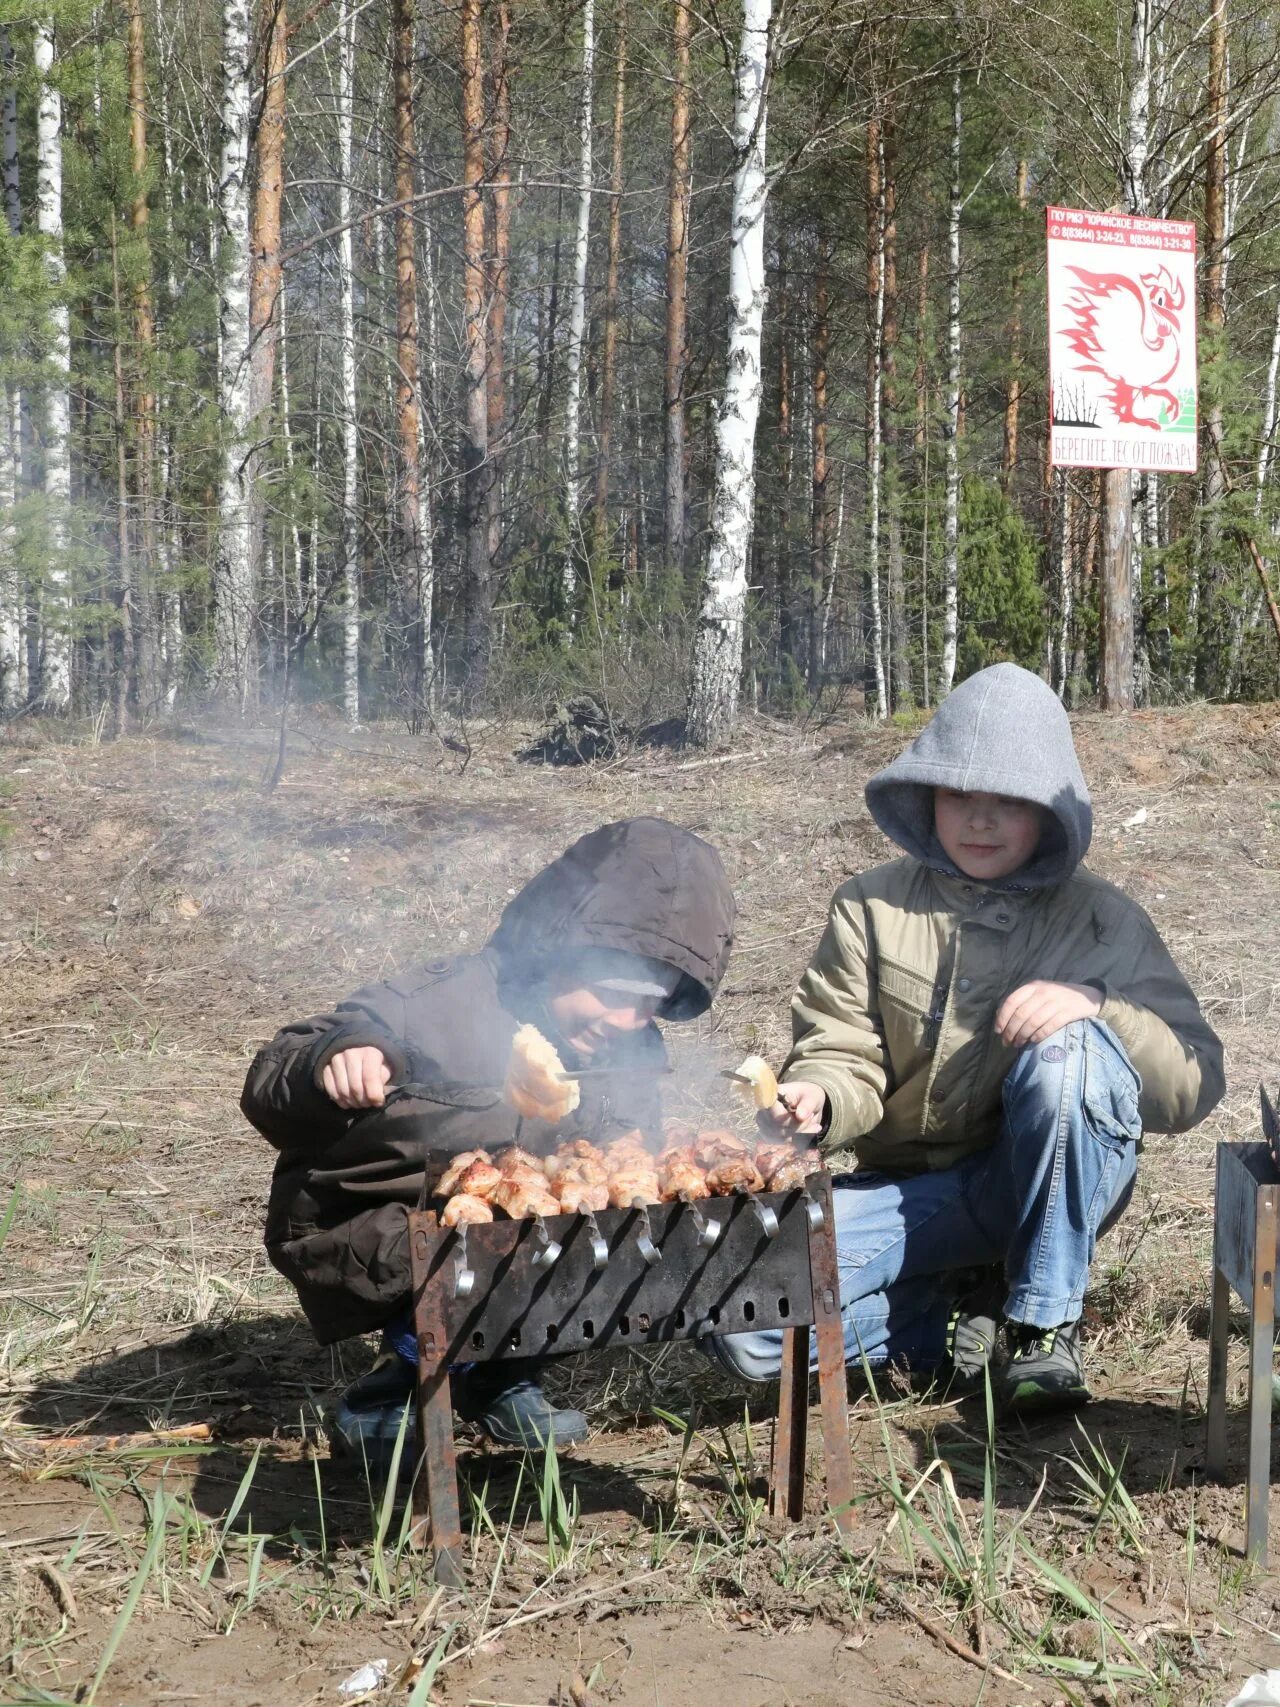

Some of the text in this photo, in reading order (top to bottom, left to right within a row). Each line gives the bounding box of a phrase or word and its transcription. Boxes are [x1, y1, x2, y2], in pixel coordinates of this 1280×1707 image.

[1051, 209, 1065, 221] ГКУ
[1066, 211, 1083, 224] РМЭ
[1133, 220, 1193, 235] ЛЕСНИЧЕСТВО"
[1055, 437, 1107, 462] БЕРЕГИТЕ
[1132, 440, 1147, 464] ОТ
